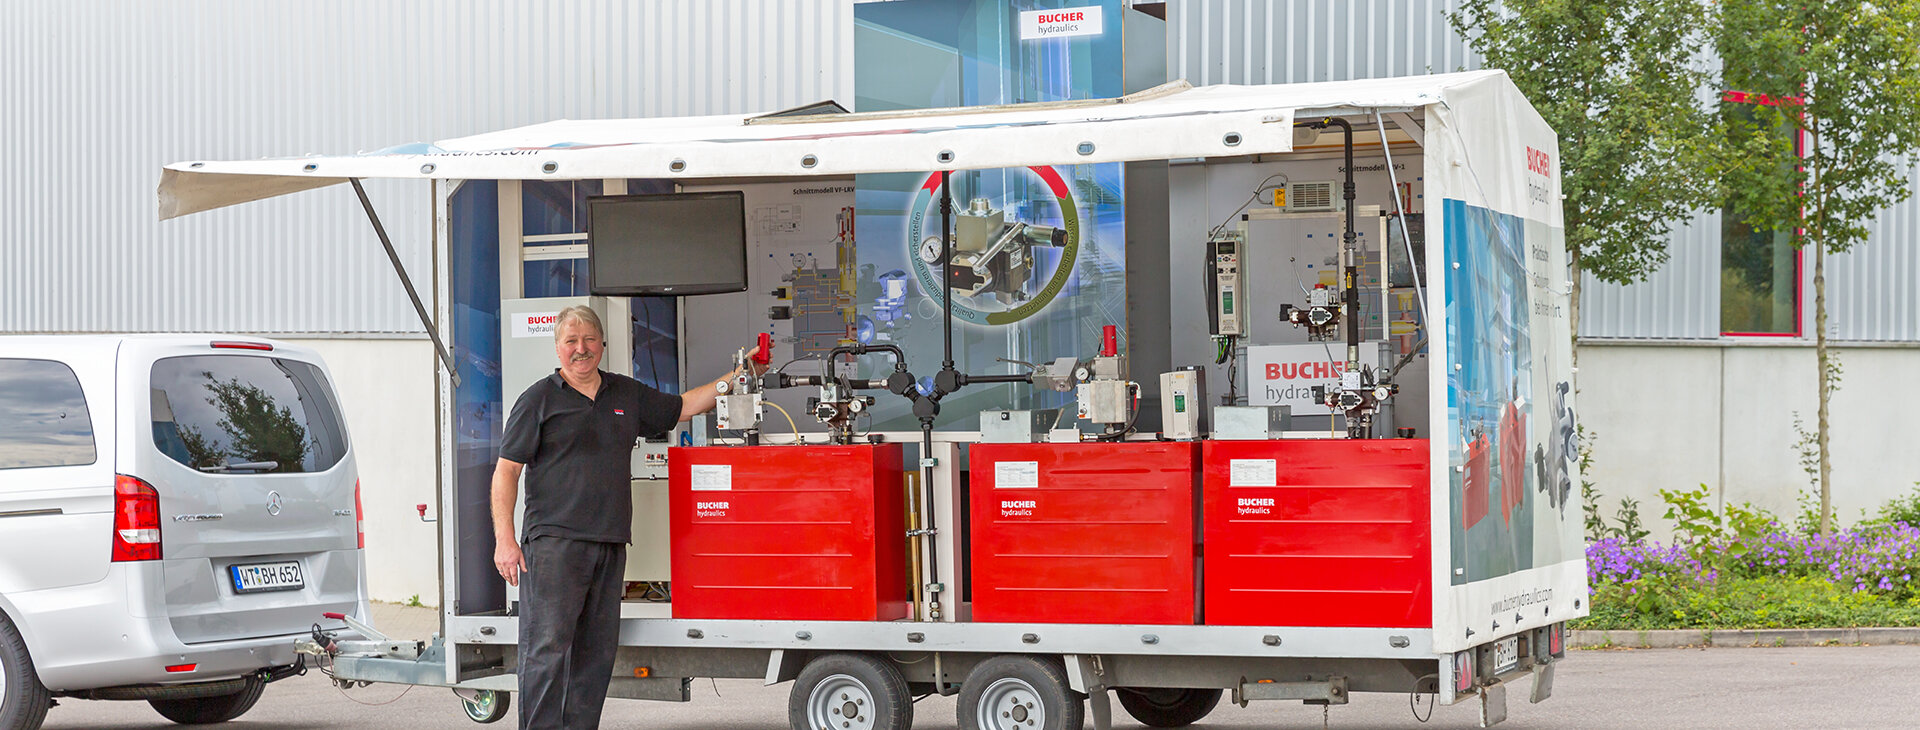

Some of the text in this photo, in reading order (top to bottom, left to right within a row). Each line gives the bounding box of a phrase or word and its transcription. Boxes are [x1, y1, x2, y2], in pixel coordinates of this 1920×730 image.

[1038, 12, 1084, 24] BUCHER
[1038, 24, 1079, 35] hydraulics
[1338, 164, 1385, 173] Scittmodell
[793, 187, 834, 195] Schnittmodell
[1067, 218, 1075, 245] Wissen
[528, 316, 558, 324] BUCHE
[528, 325, 554, 334] hydrauli
[1265, 361, 1348, 380] BUCHE
[1266, 383, 1340, 403] hydralic
[1238, 498, 1275, 506] BUCHER
[697, 510, 726, 518] hydraulics
[1001, 509, 1032, 517] hydraulics
[1238, 507, 1270, 515] hydraulics
[240, 565, 300, 586] WT BH 652
